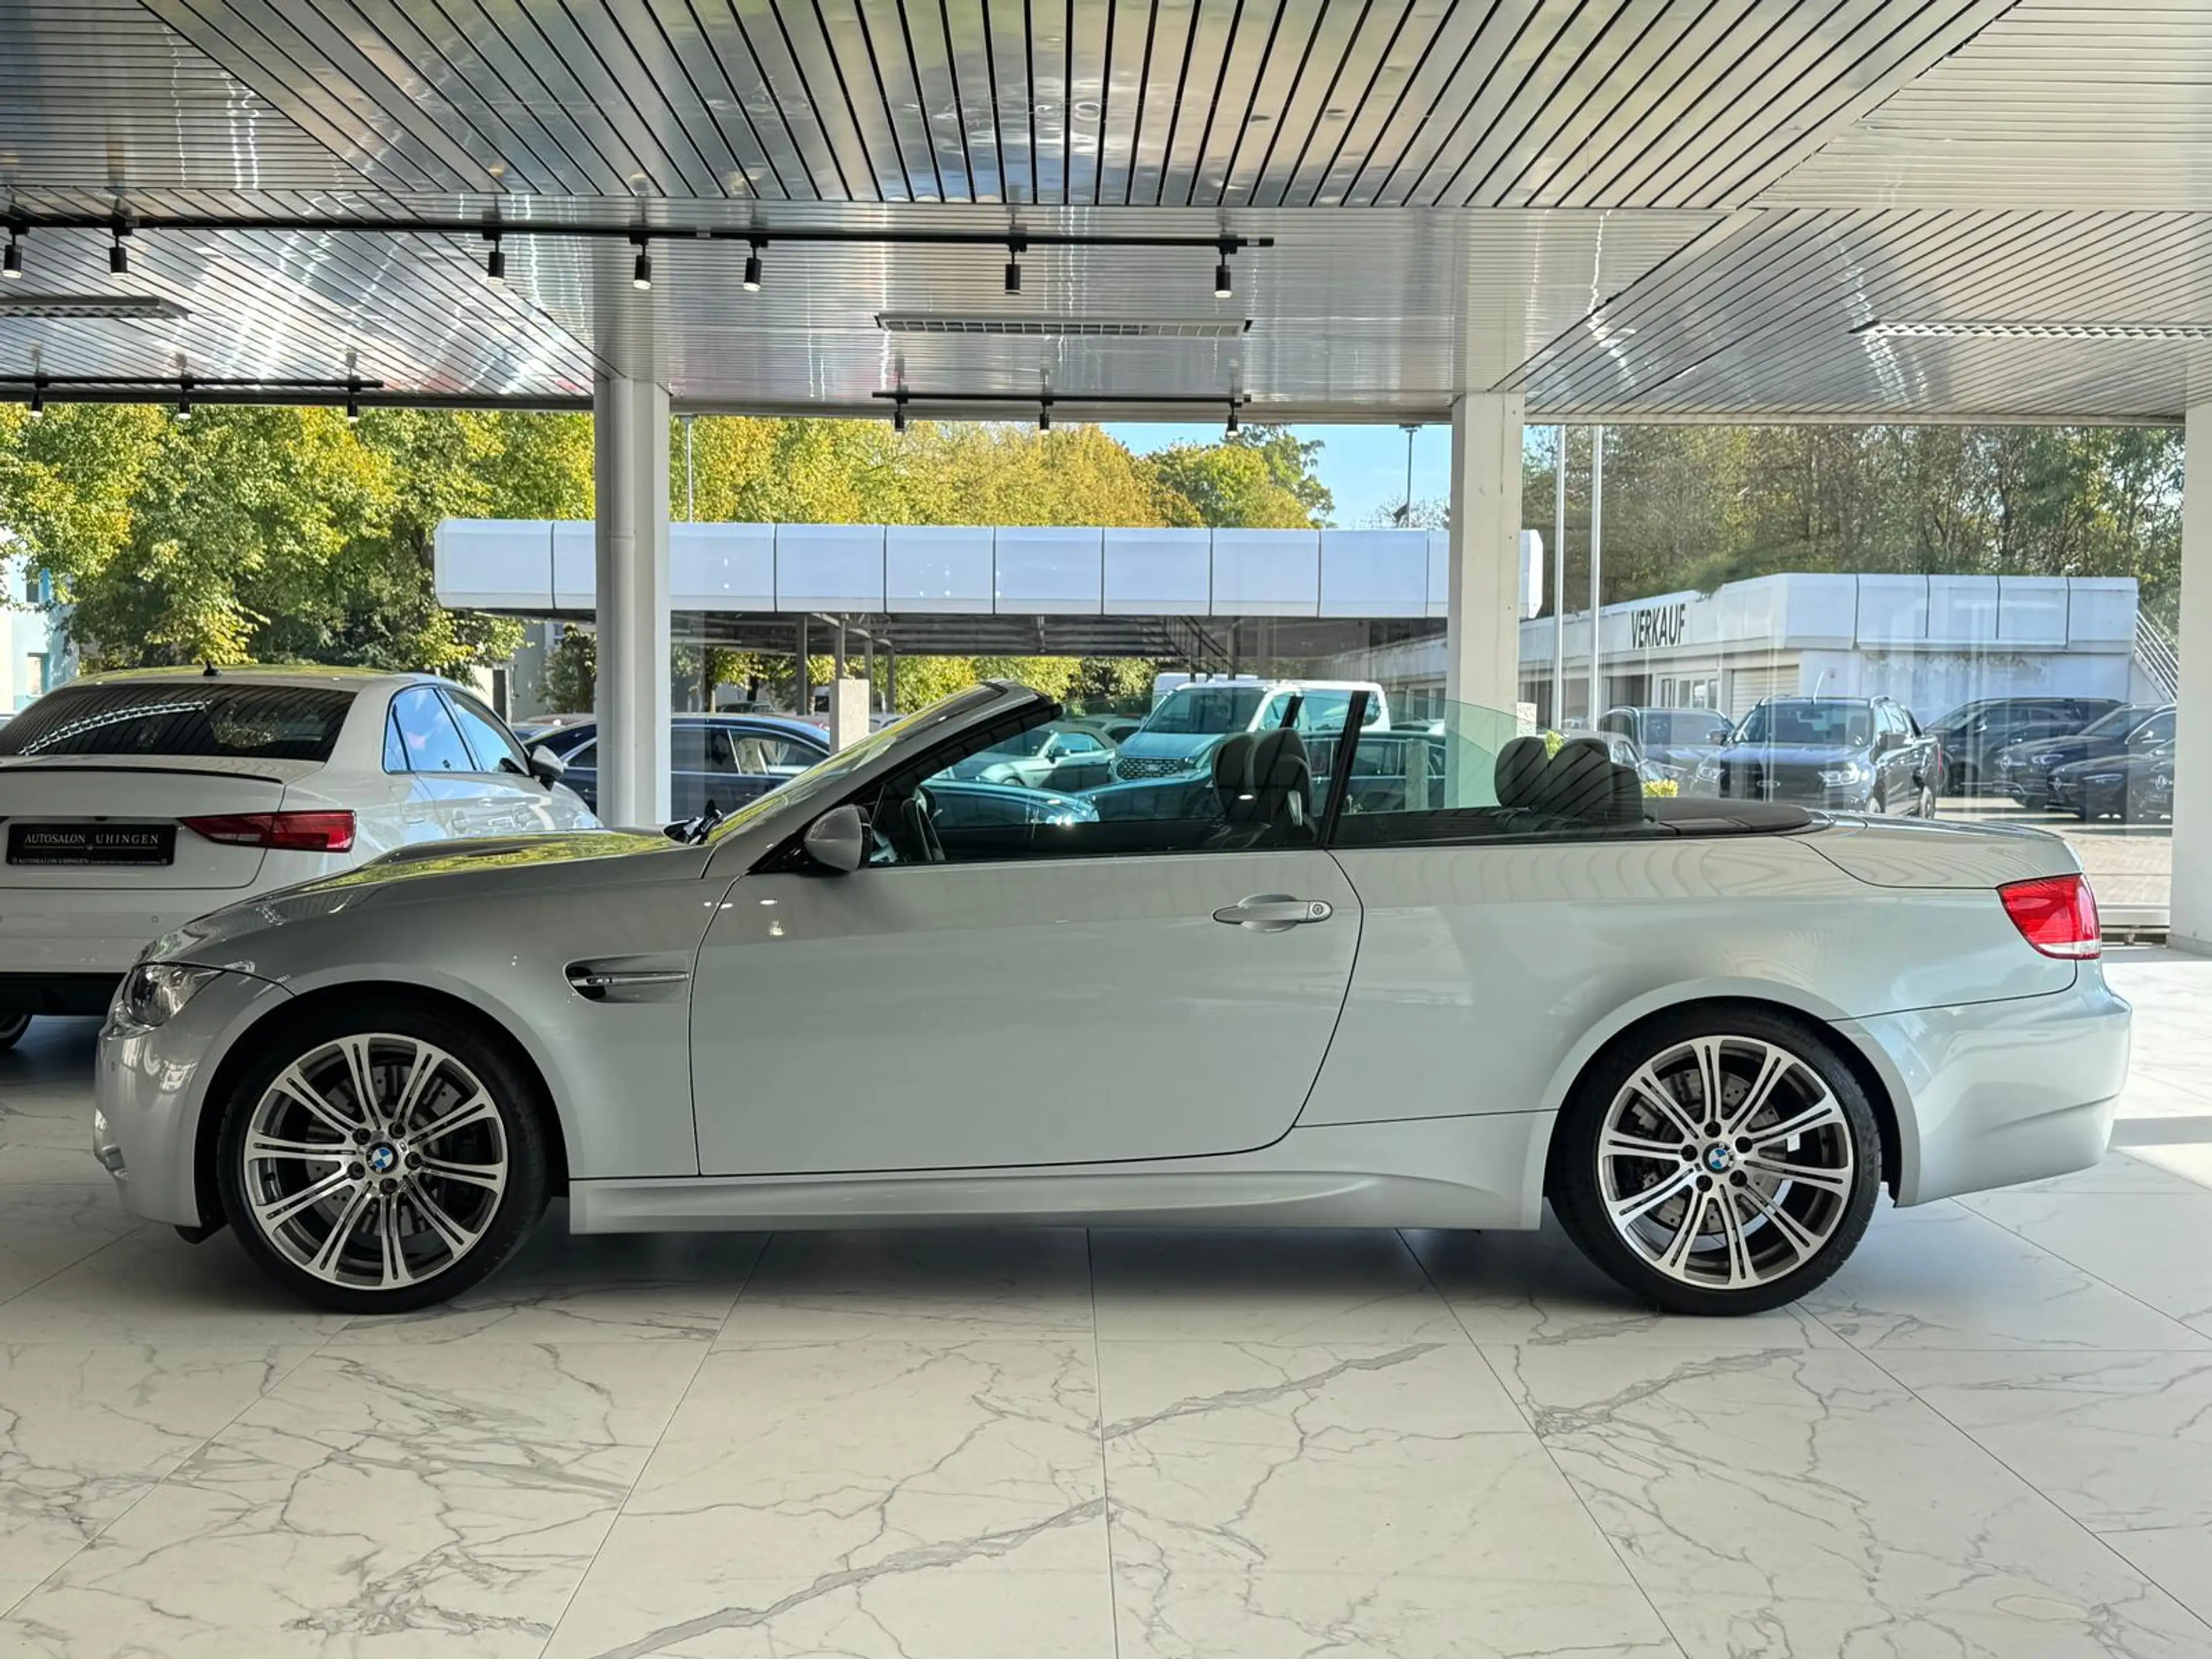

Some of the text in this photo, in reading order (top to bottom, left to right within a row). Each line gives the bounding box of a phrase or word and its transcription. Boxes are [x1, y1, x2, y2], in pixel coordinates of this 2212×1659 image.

[1631, 604, 1685, 649] VERKAUF
[25, 834, 159, 844] AUTOSALON UHINGEN
